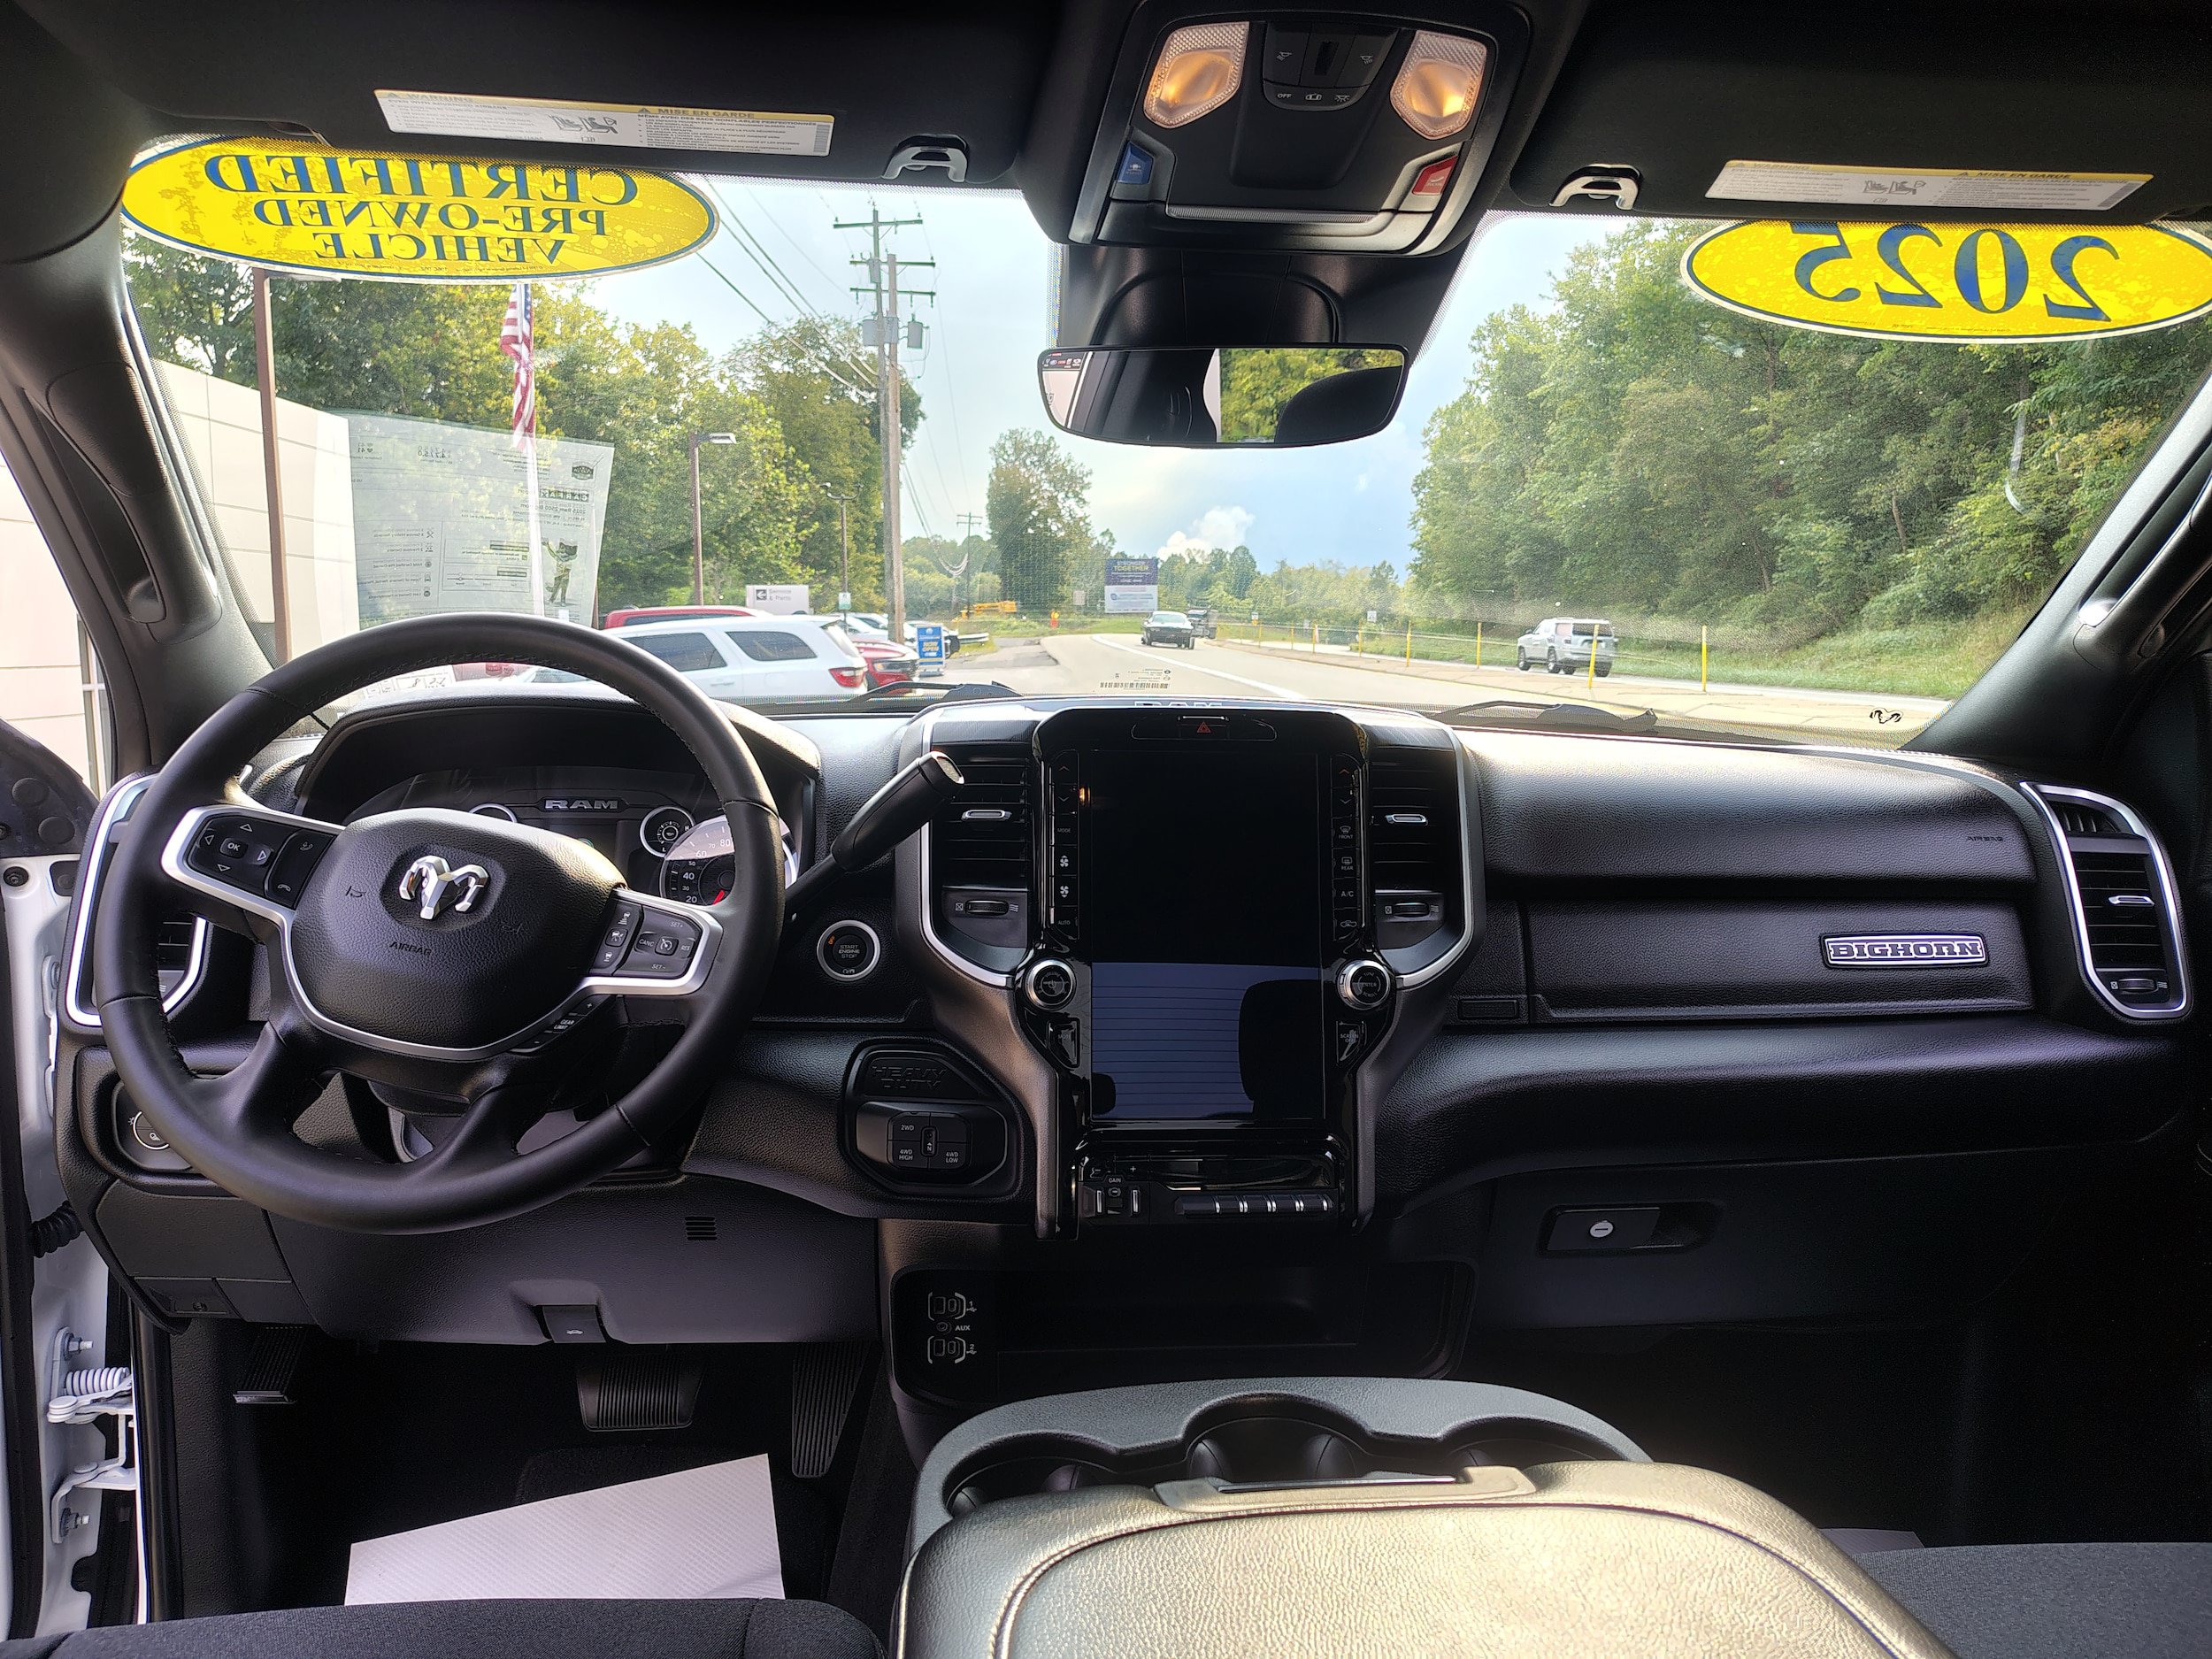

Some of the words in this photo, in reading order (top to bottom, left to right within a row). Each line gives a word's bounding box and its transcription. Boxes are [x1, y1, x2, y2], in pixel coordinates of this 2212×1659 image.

[407, 91, 472, 103] WARNING
[544, 799, 618, 810] RAM
[227, 841, 240, 851] OK
[719, 838, 731, 847] 80
[695, 849, 707, 858] 60
[682, 872, 695, 880] 40
[389, 941, 433, 956] AIRBAG
[639, 939, 655, 948] CANC
[1829, 941, 1984, 960] BIGHORN
[872, 1065, 947, 1079] HEAVY
[880, 1078, 941, 1090] DUTY
